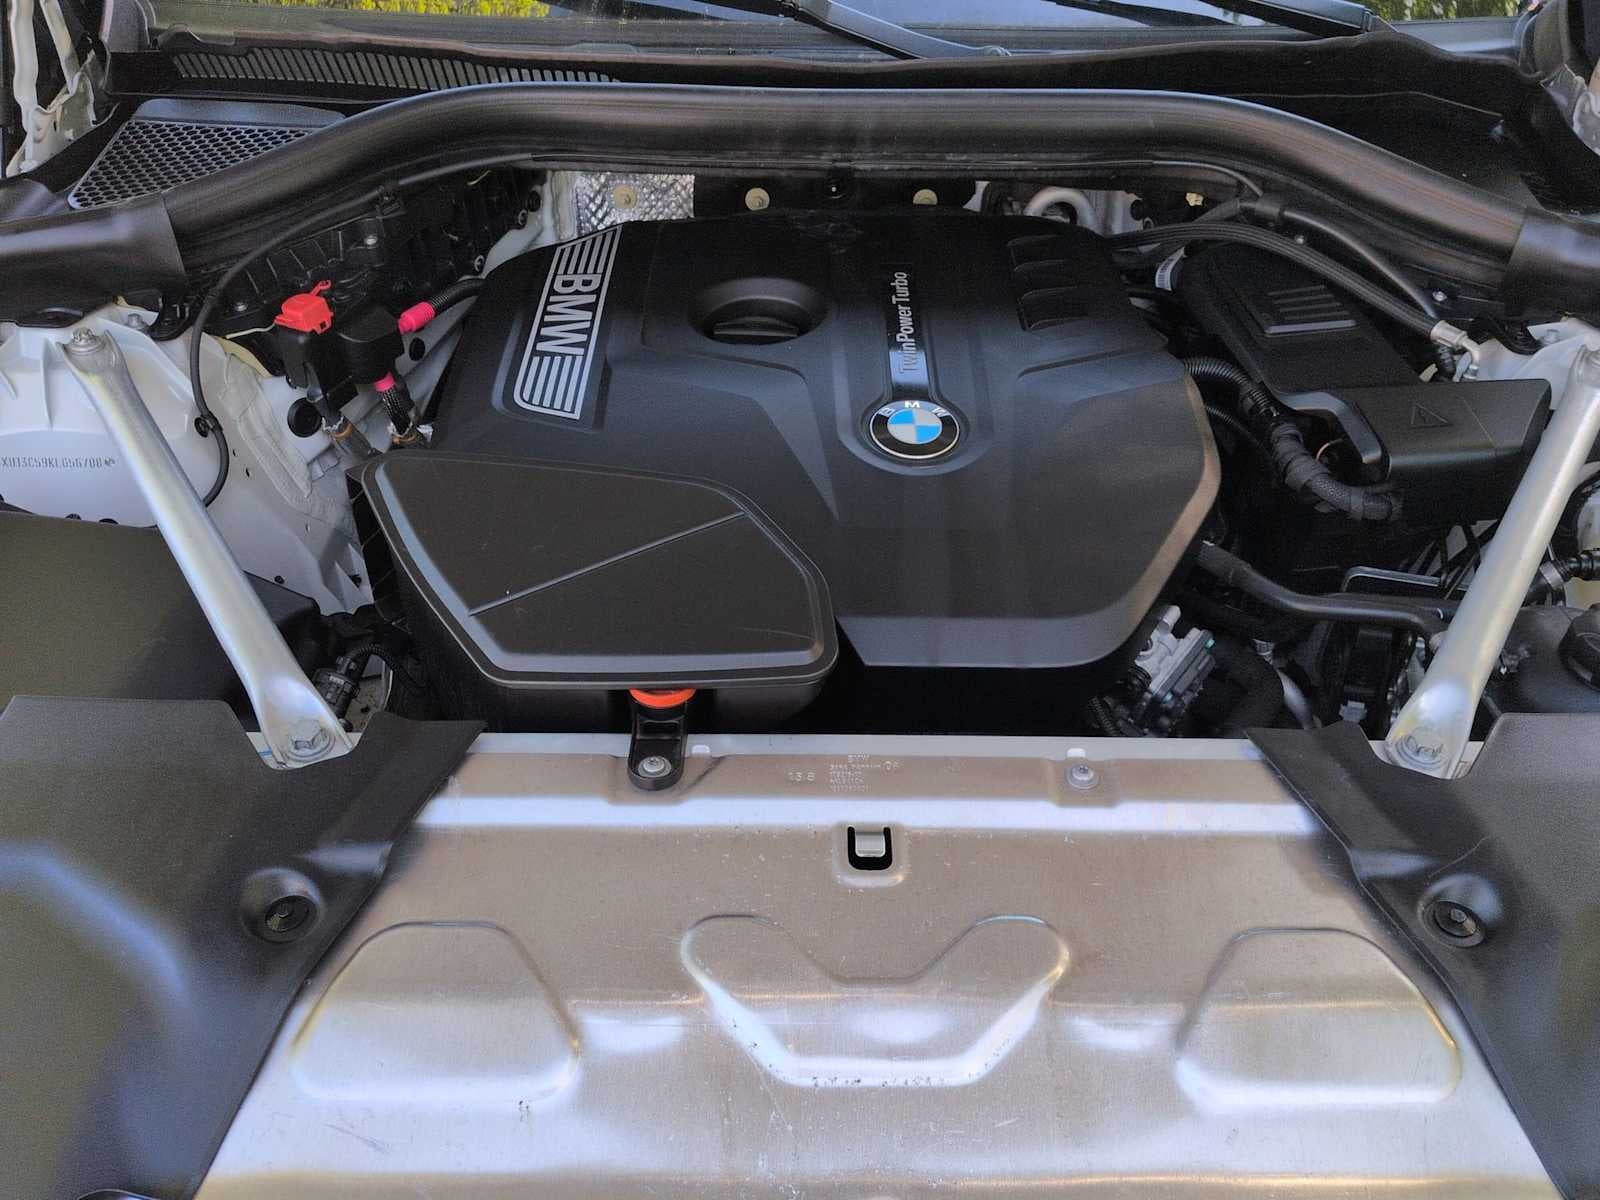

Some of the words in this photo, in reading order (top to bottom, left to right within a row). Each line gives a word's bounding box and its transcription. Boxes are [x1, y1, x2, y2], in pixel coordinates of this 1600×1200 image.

[890, 271, 910, 305] Turbo
[535, 273, 602, 356] BMW
[896, 304, 919, 374] TwinPower
[878, 400, 951, 418] BMW
